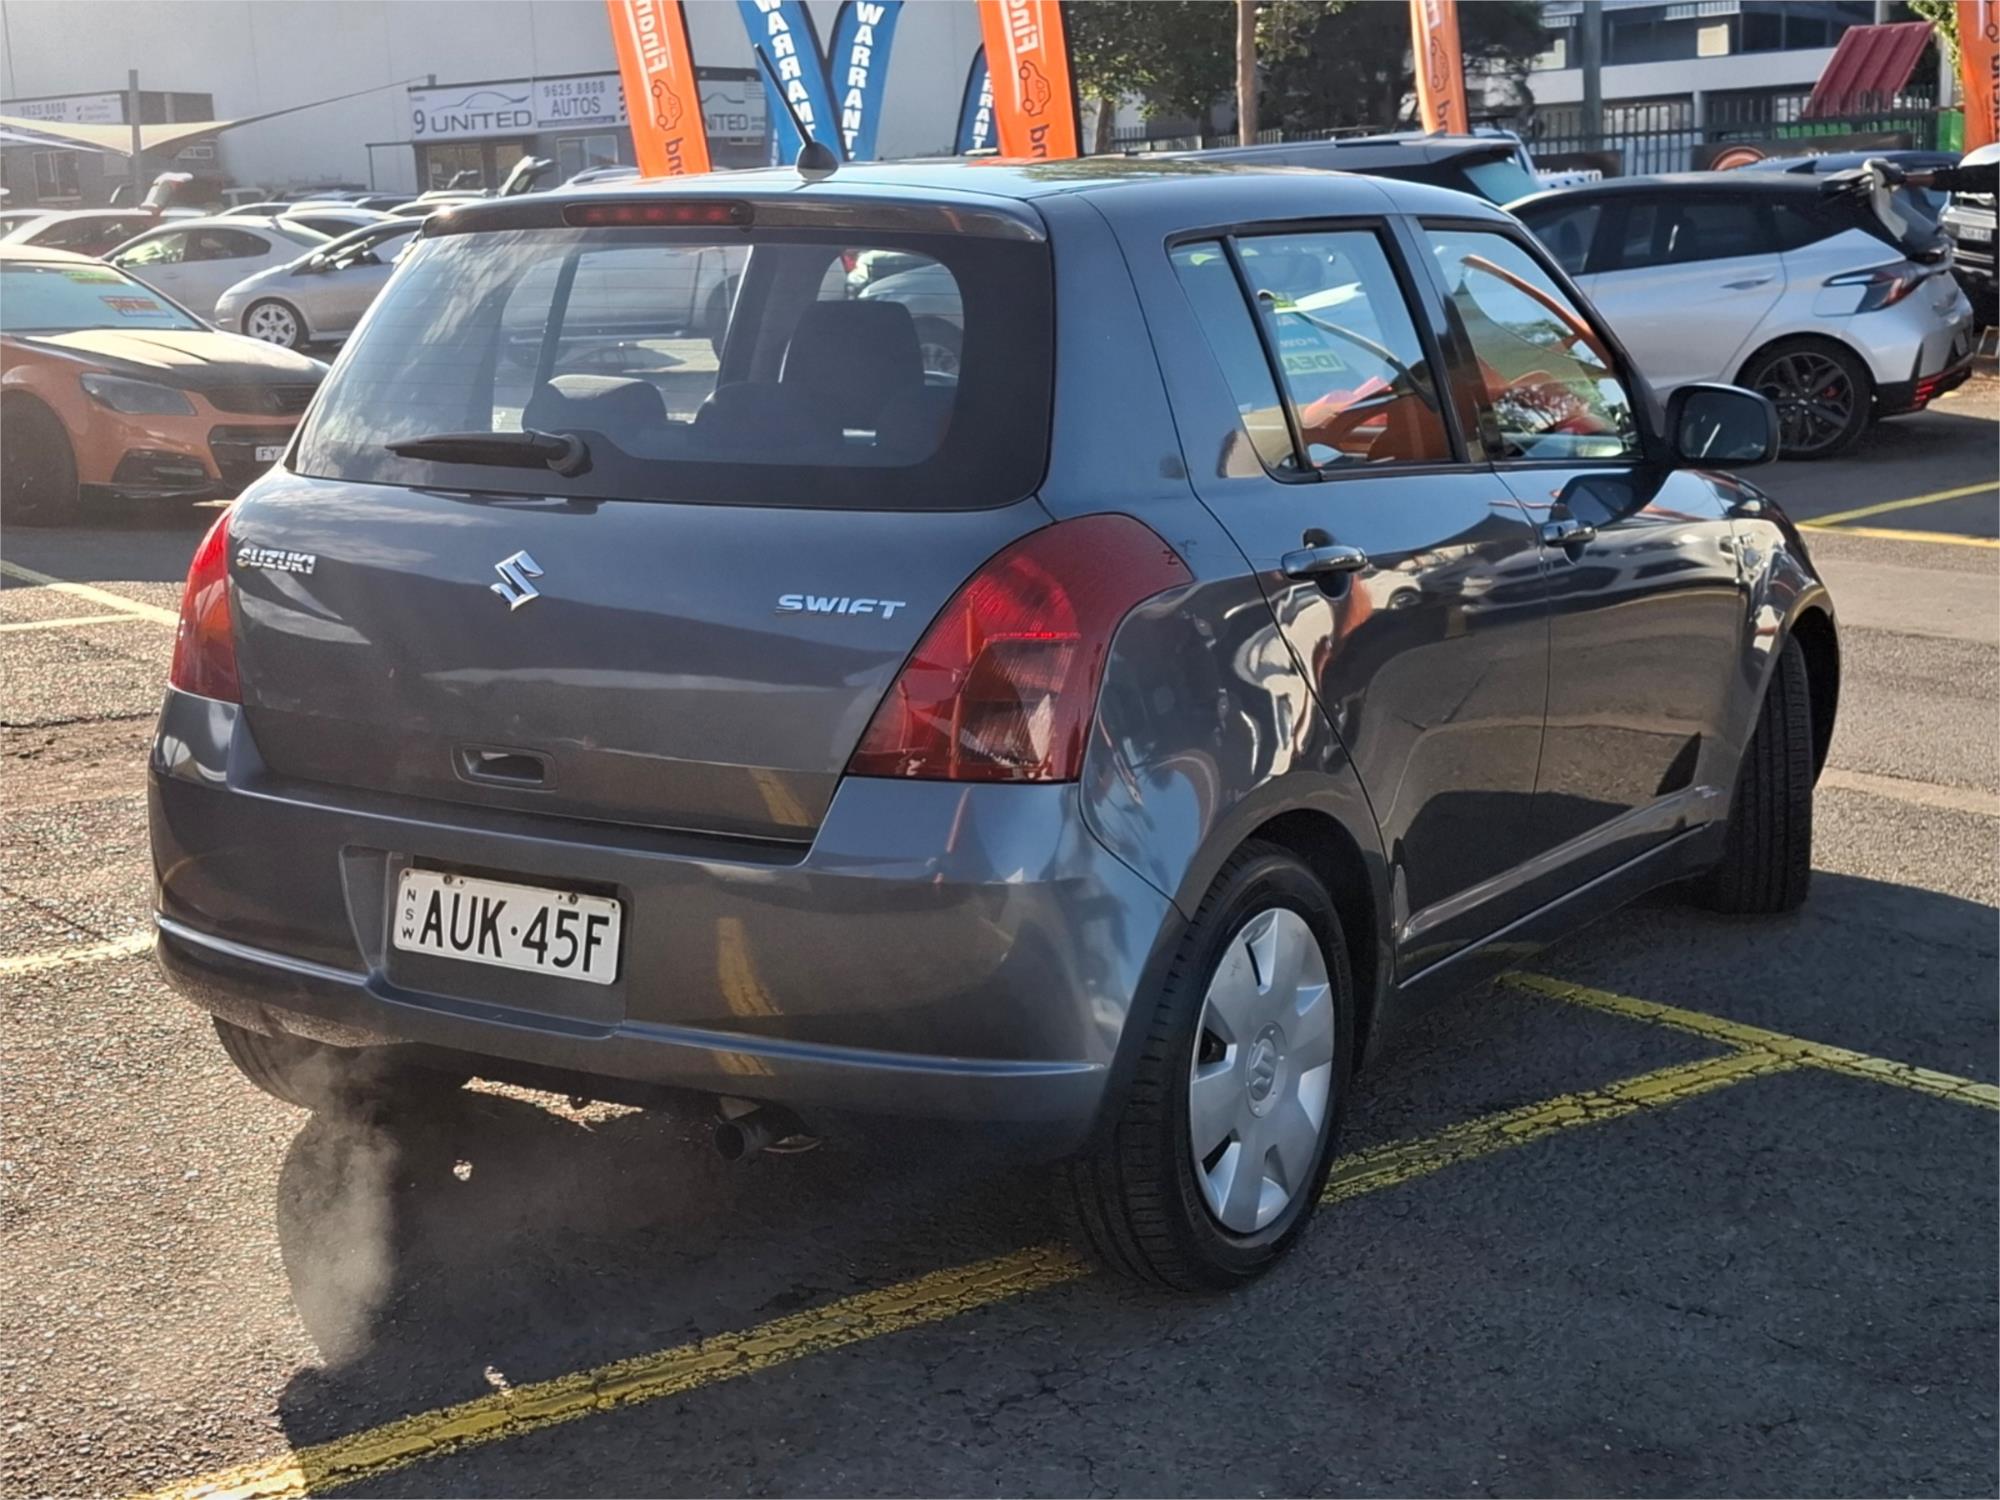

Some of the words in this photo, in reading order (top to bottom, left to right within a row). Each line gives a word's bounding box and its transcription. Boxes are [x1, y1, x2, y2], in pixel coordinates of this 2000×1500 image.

[551, 96, 601, 117] AUTOS
[430, 110, 533, 133] UNITED
[236, 547, 316, 574] SUZUKI
[776, 594, 906, 620] SWIFT
